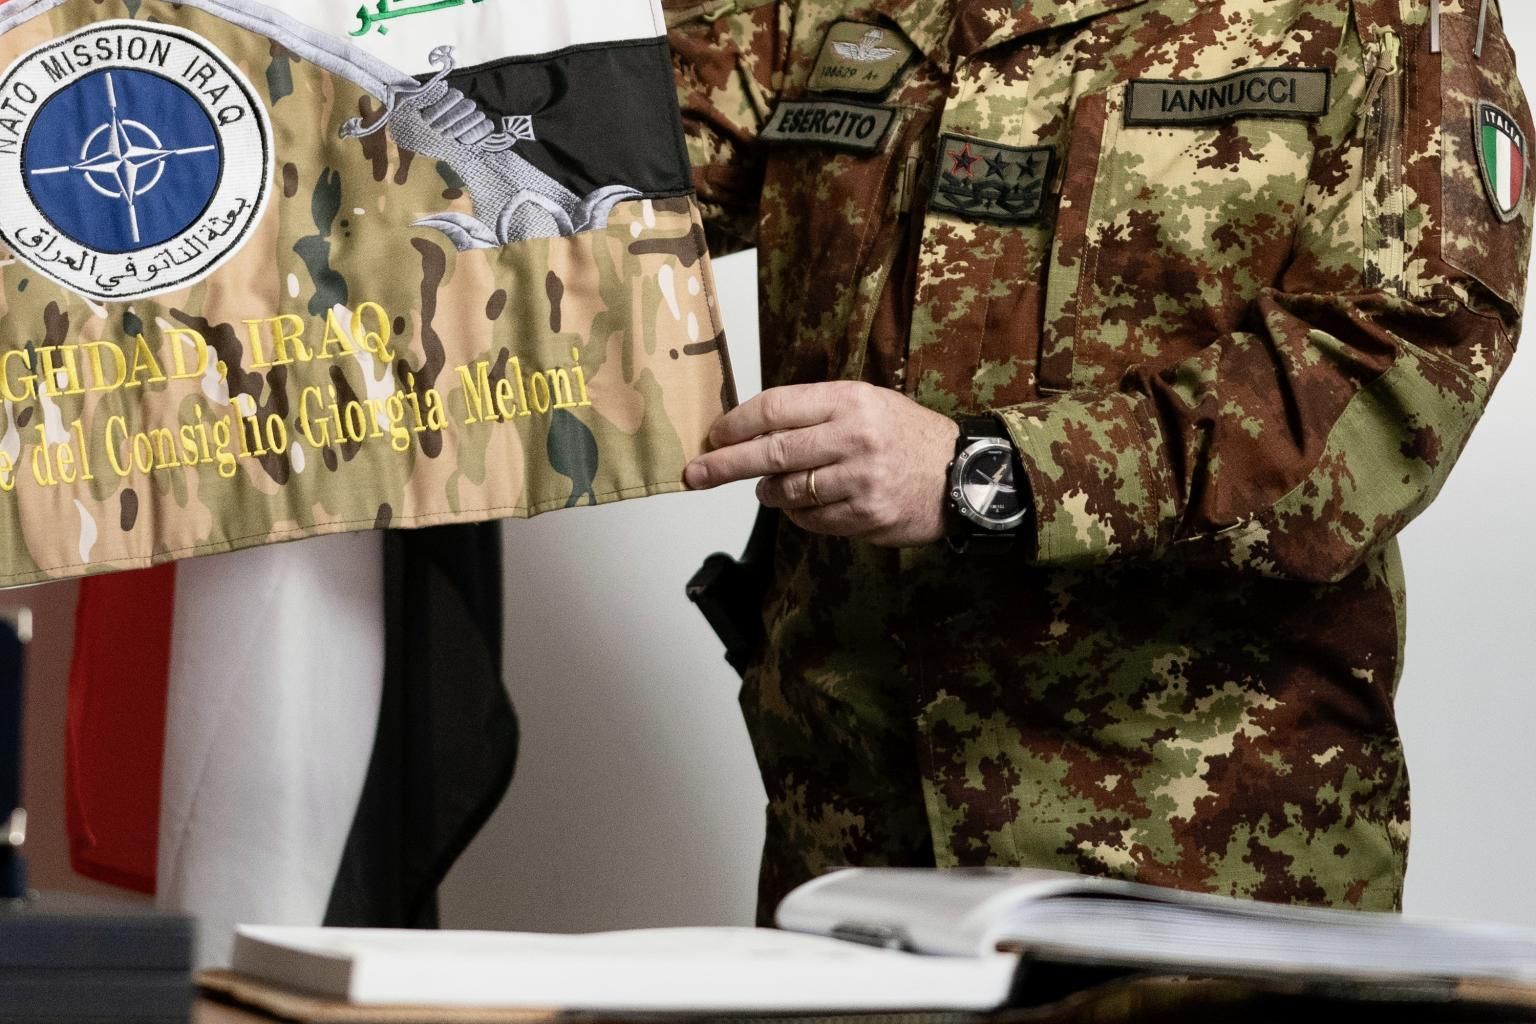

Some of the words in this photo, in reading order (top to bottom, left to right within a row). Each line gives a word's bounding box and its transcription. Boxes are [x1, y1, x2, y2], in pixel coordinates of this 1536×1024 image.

[40, 36, 172, 83] MISSION
[182, 55, 246, 127] IRAQ
[1161, 77, 1297, 113] IANNUCCI
[776, 109, 876, 140] ESERCITO
[1484, 109, 1522, 148] ITALIA
[14, 226, 98, 276] العراق
[95, 256, 137, 292] في
[242, 302, 396, 370] IRAQ
[32, 419, 94, 487] del
[105, 395, 288, 478] Consiglio
[300, 373, 449, 452] Giorgia
[455, 347, 592, 425] Meloni
